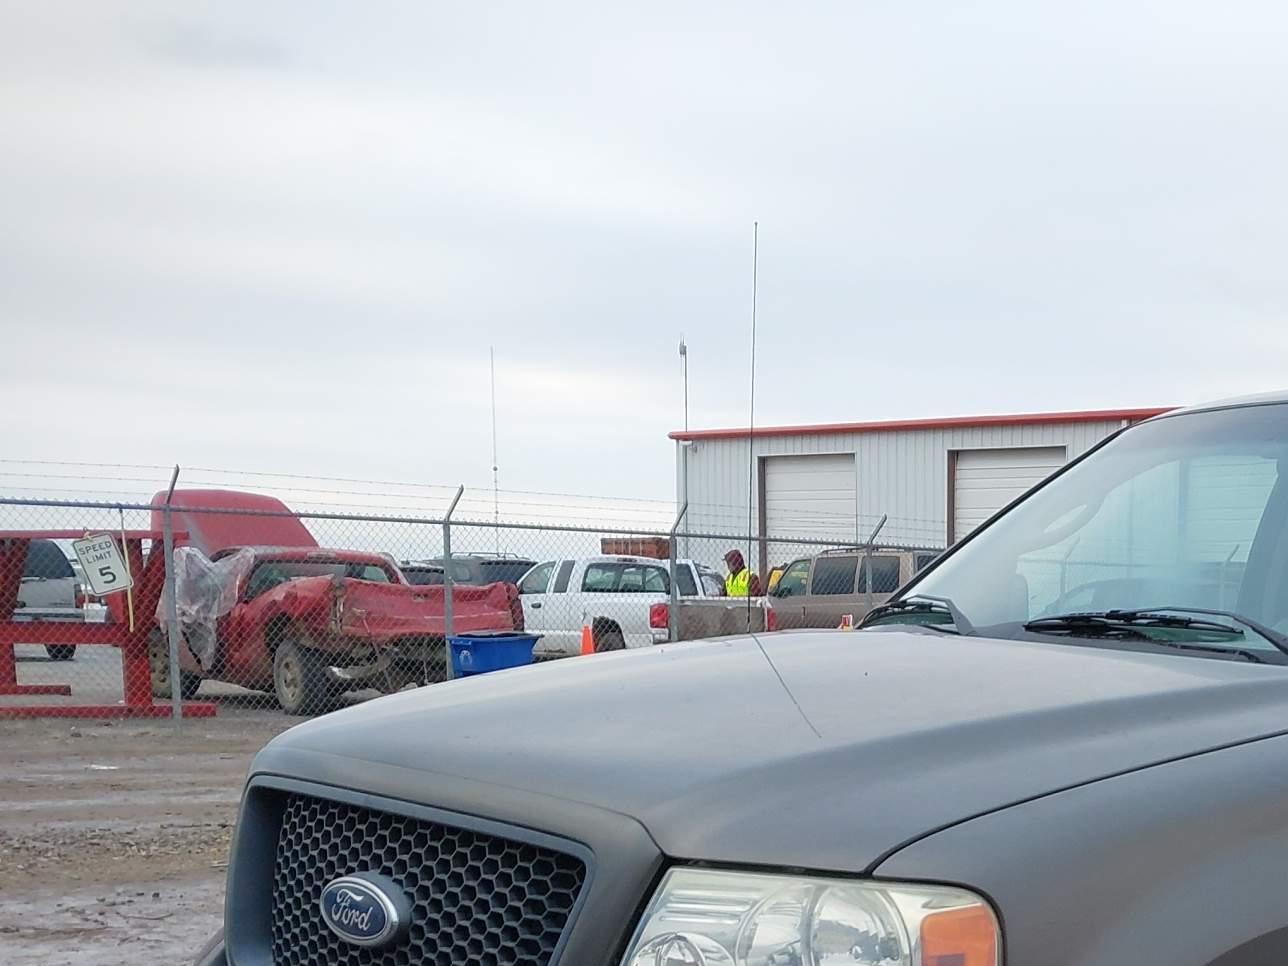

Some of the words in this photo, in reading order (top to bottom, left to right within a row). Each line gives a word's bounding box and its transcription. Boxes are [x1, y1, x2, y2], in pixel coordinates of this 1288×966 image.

[78, 541, 112, 556] SPEED
[85, 551, 112, 564] LIMIT
[98, 566, 117, 584] 5
[331, 888, 374, 931] Ford
